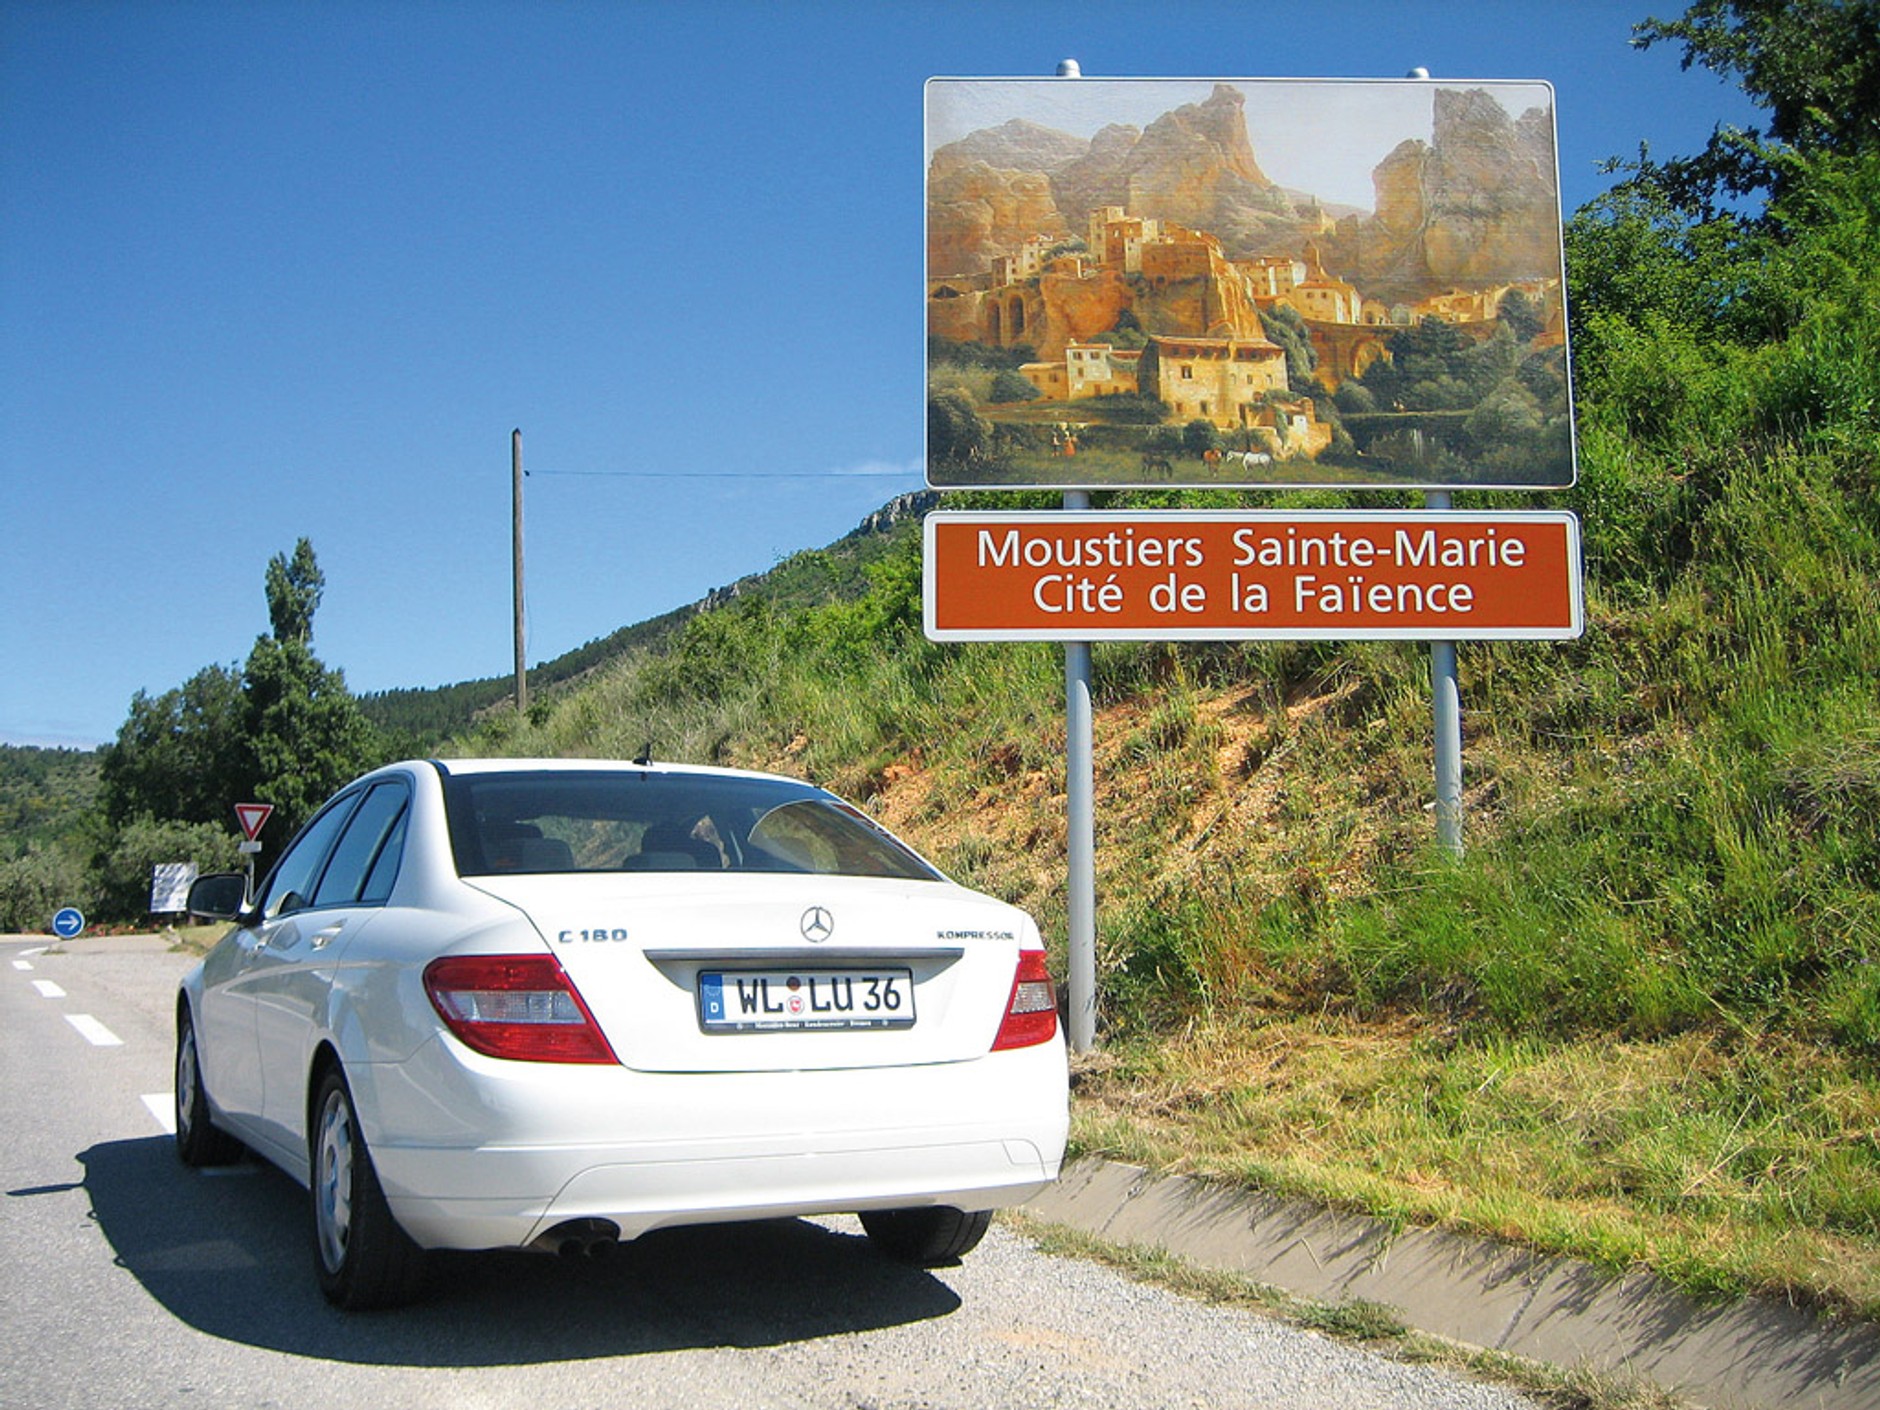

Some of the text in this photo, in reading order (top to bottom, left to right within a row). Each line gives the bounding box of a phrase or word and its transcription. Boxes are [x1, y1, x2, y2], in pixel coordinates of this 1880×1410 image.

[977, 528, 1525, 567] Moustiers Sainte-Marie
[1033, 572, 1474, 613] Cité de la Faïence
[559, 929, 628, 944] C 180
[936, 930, 1015, 942] KOMPRESSOR
[709, 1002, 719, 1013] D
[737, 976, 901, 1014] WL LU 36
